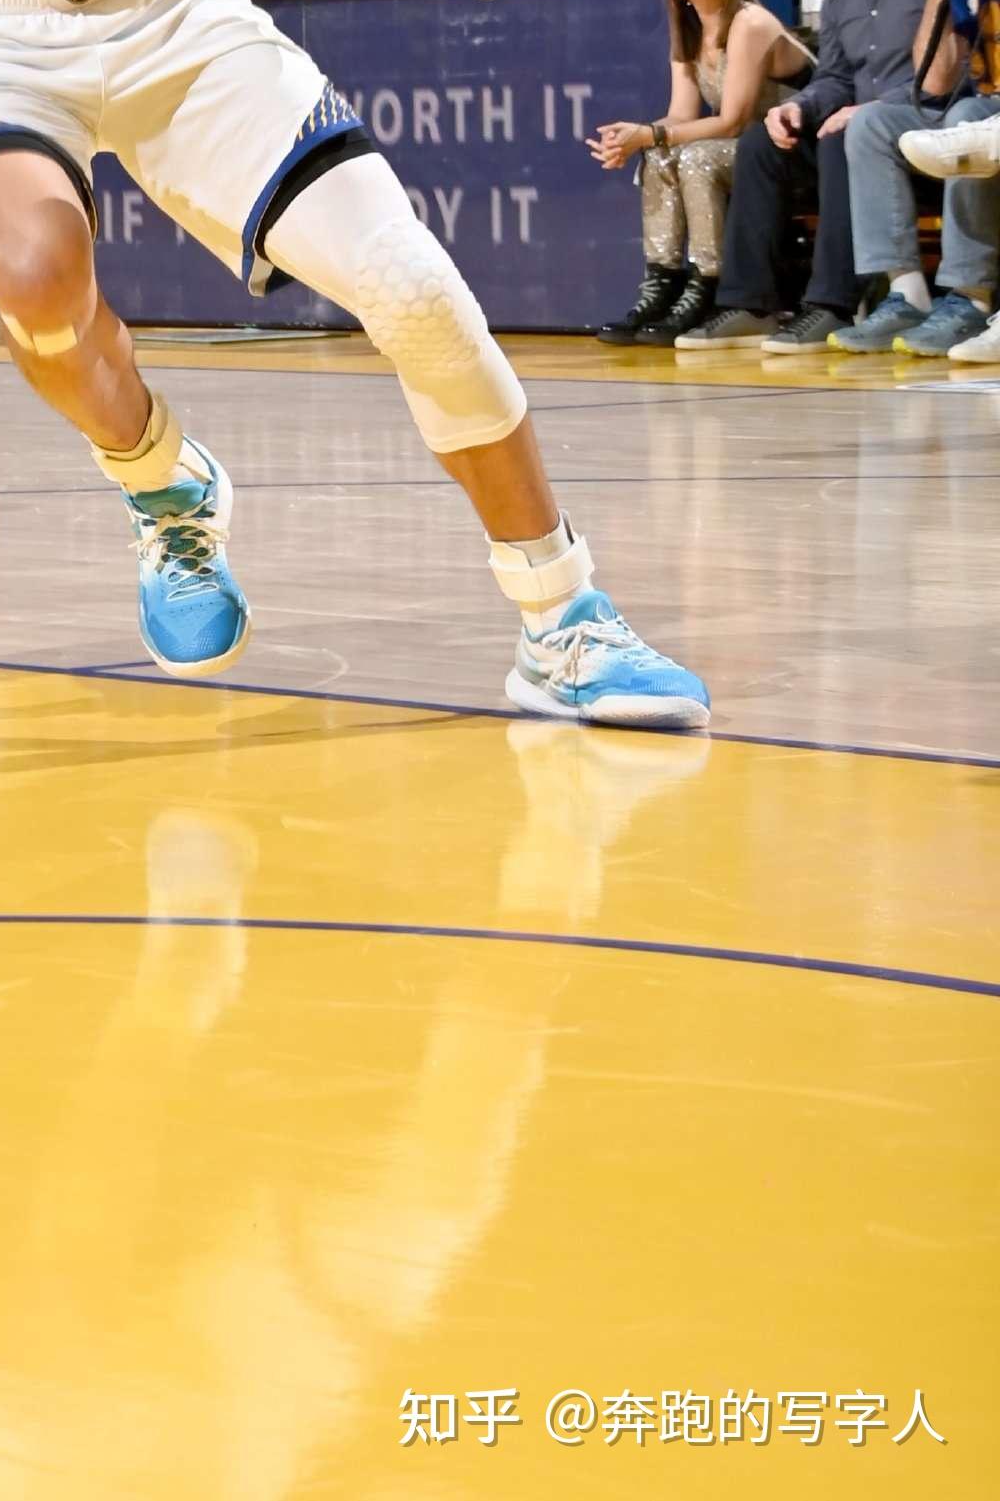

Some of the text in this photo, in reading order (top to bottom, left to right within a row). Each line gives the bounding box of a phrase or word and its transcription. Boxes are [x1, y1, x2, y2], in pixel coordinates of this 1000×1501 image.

[544, 84, 593, 142] IT
[103, 190, 144, 245] IF
[491, 186, 539, 245] IT
